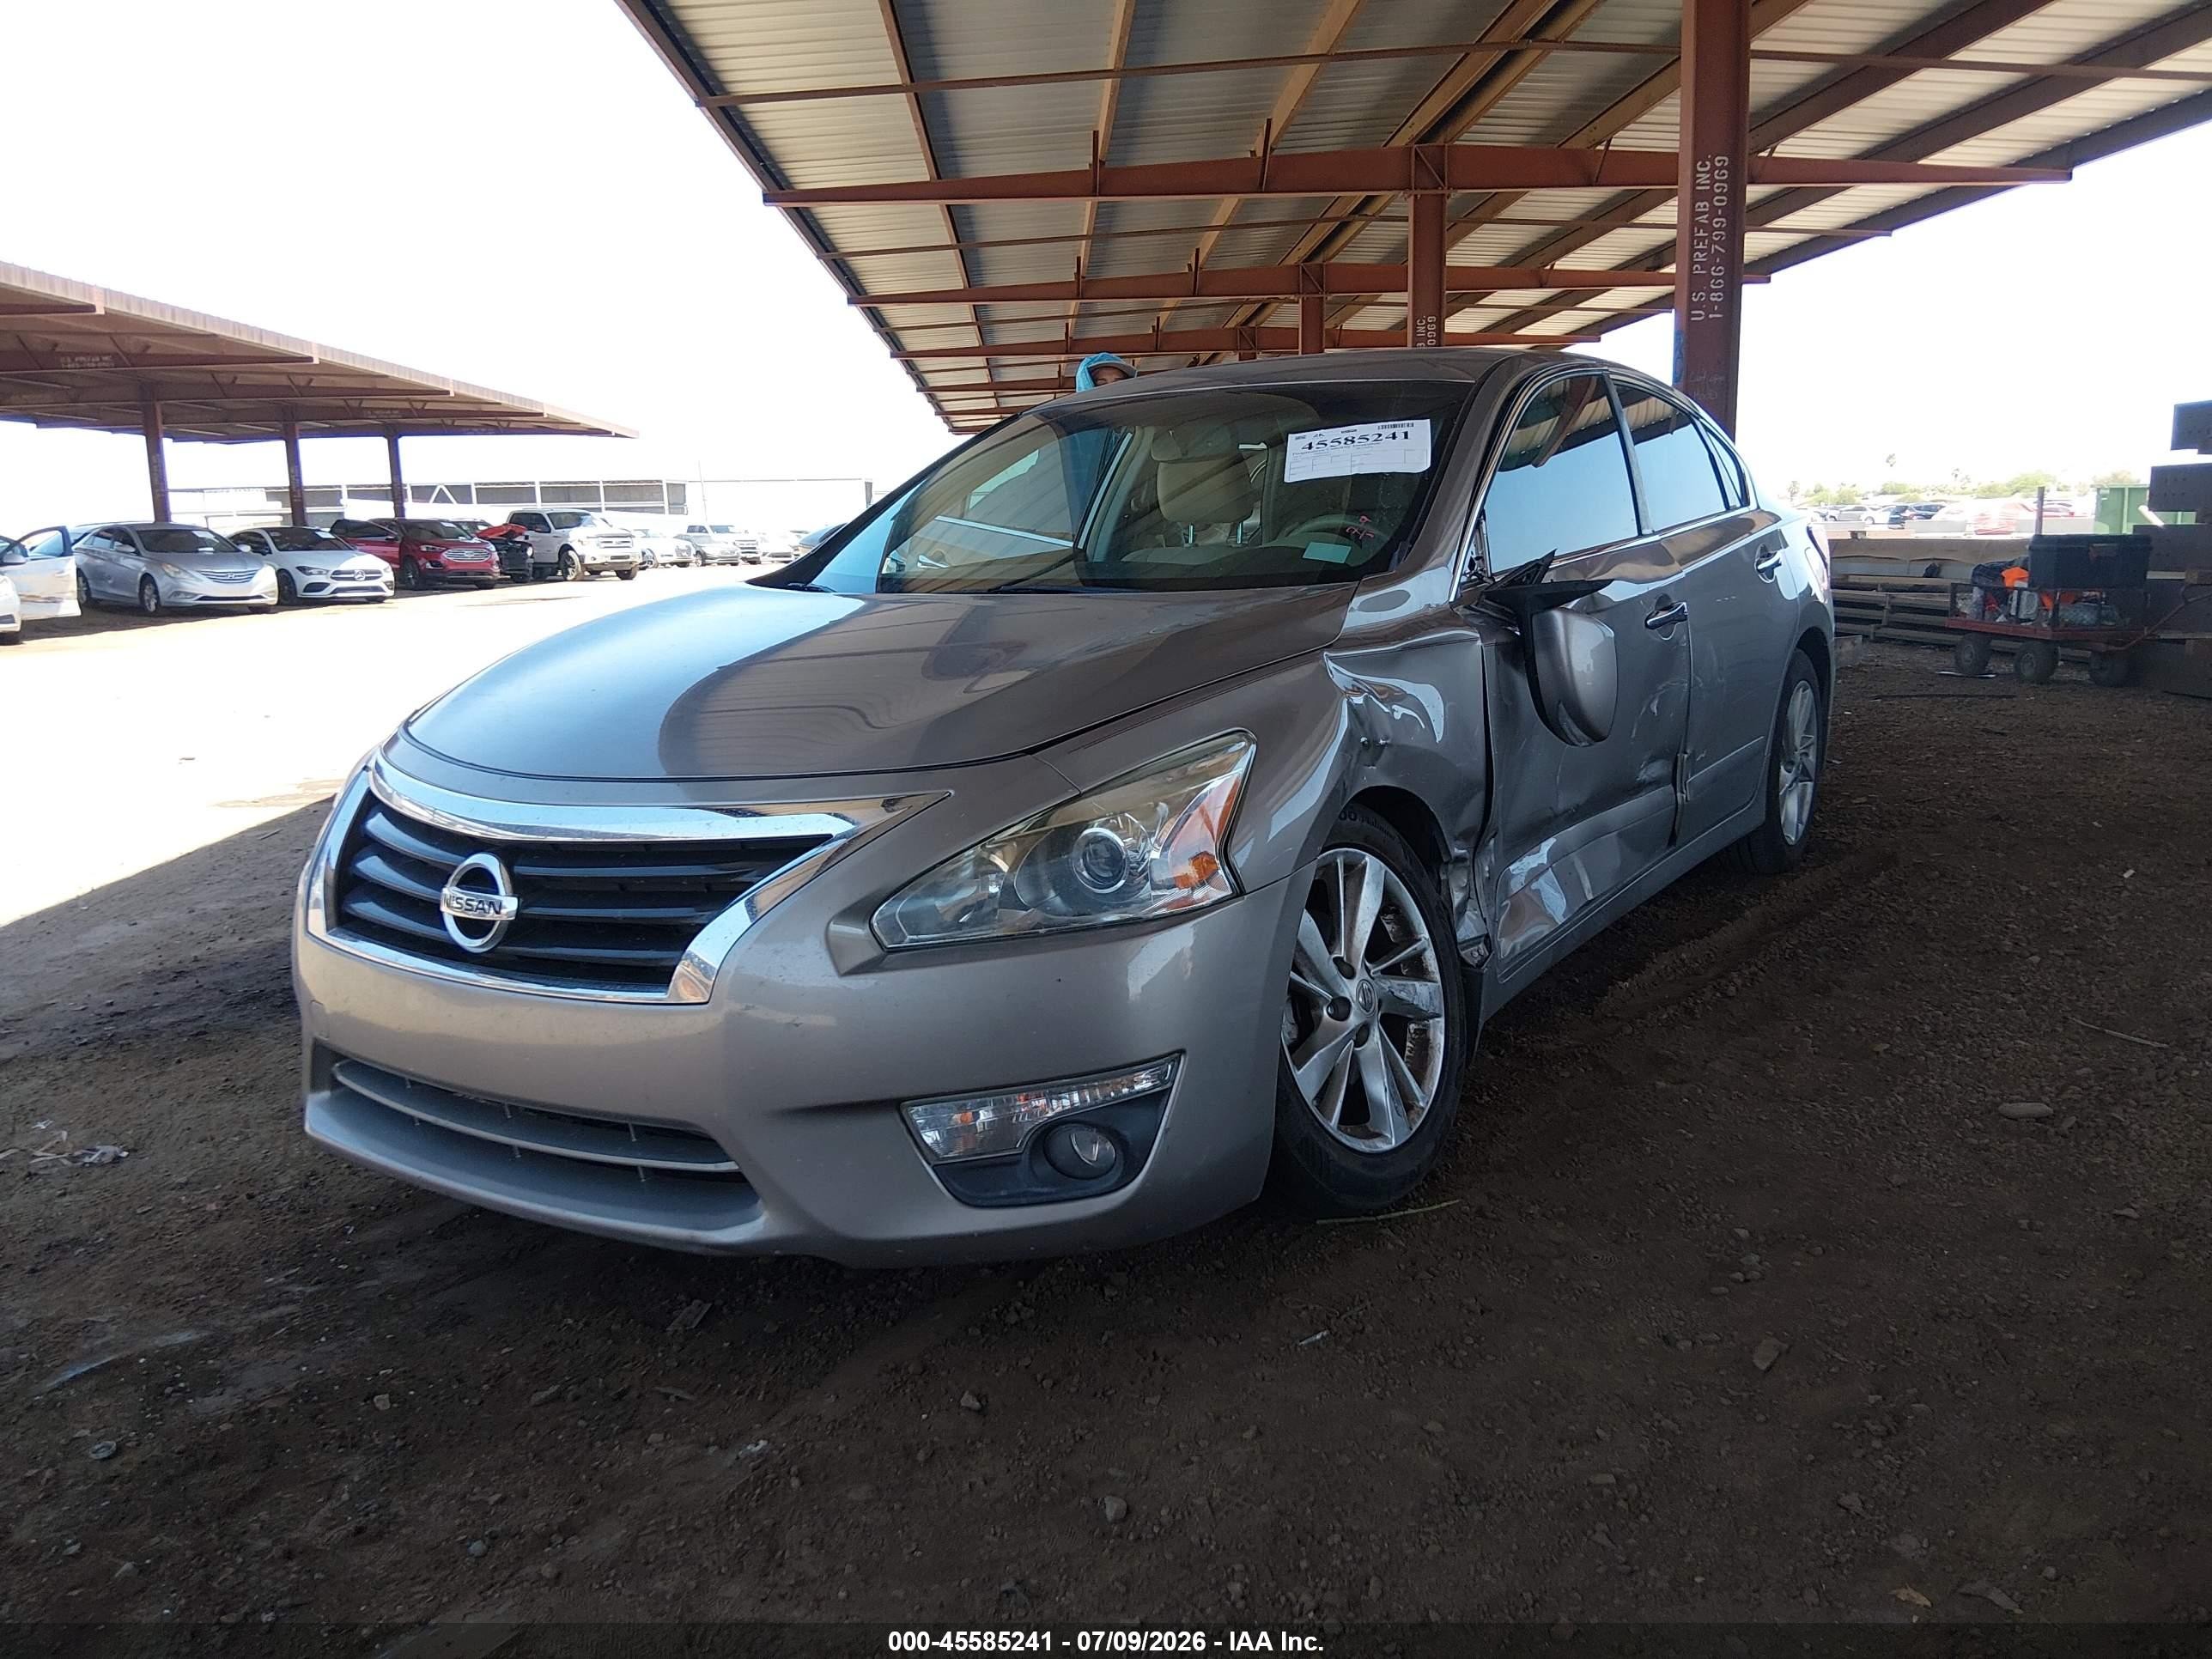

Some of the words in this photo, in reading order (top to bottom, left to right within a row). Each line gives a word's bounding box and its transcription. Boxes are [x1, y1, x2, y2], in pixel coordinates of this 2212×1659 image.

[1696, 154, 1711, 190] INC.
[1692, 201, 1710, 274] PREFAB
[1709, 155, 1729, 319] 1-866-799-0969
[1301, 430, 1411, 451] 45585241
[443, 895, 502, 915] NISSAN
